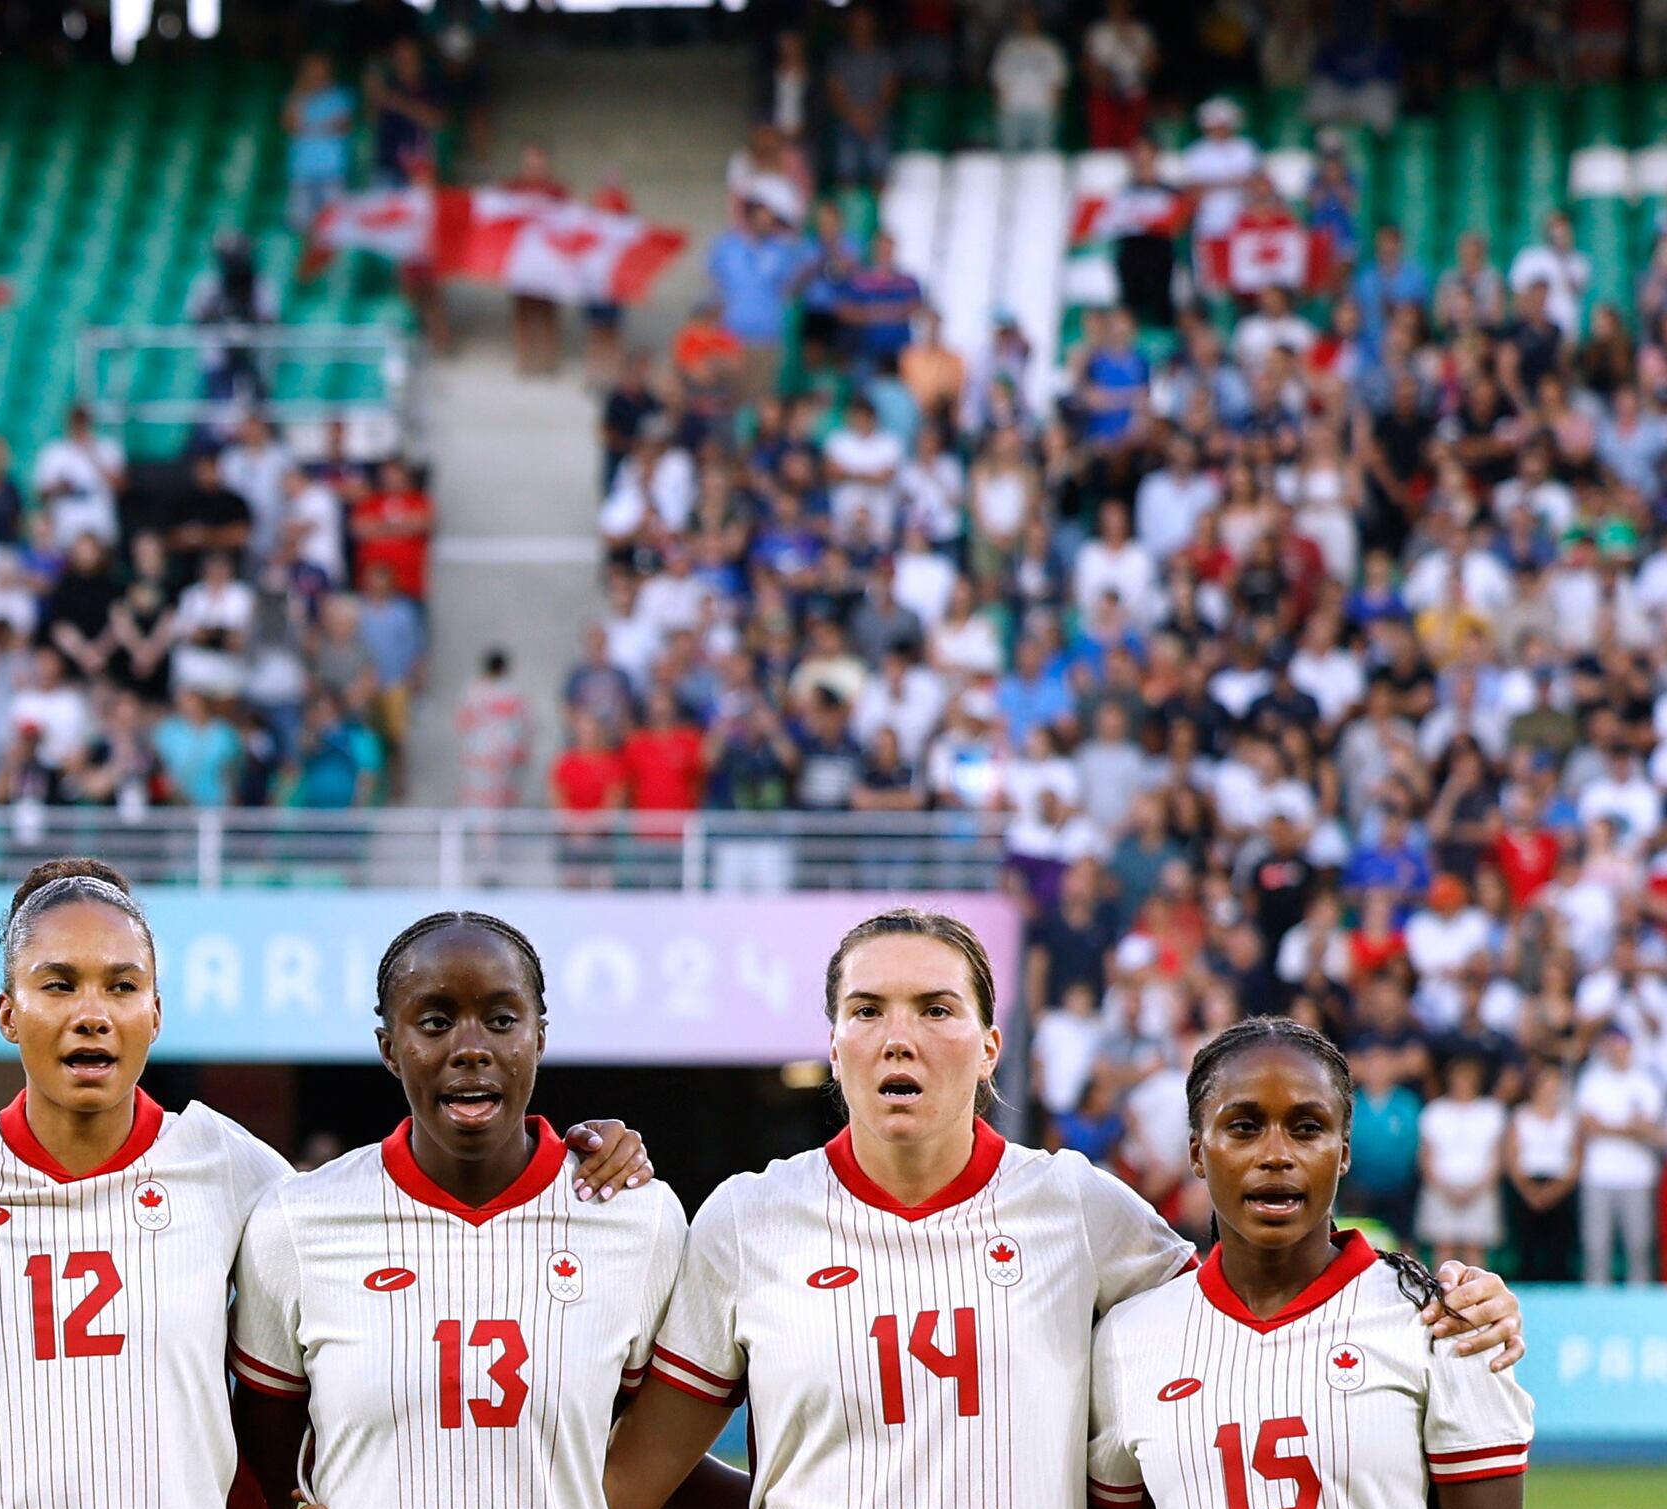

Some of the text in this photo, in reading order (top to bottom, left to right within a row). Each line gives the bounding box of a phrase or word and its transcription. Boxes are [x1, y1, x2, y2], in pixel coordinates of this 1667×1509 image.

[181, 931, 791, 1018] ARI 024
[24, 1250, 125, 1361] 12
[432, 1319, 529, 1430] 13
[870, 1307, 980, 1426] 14
